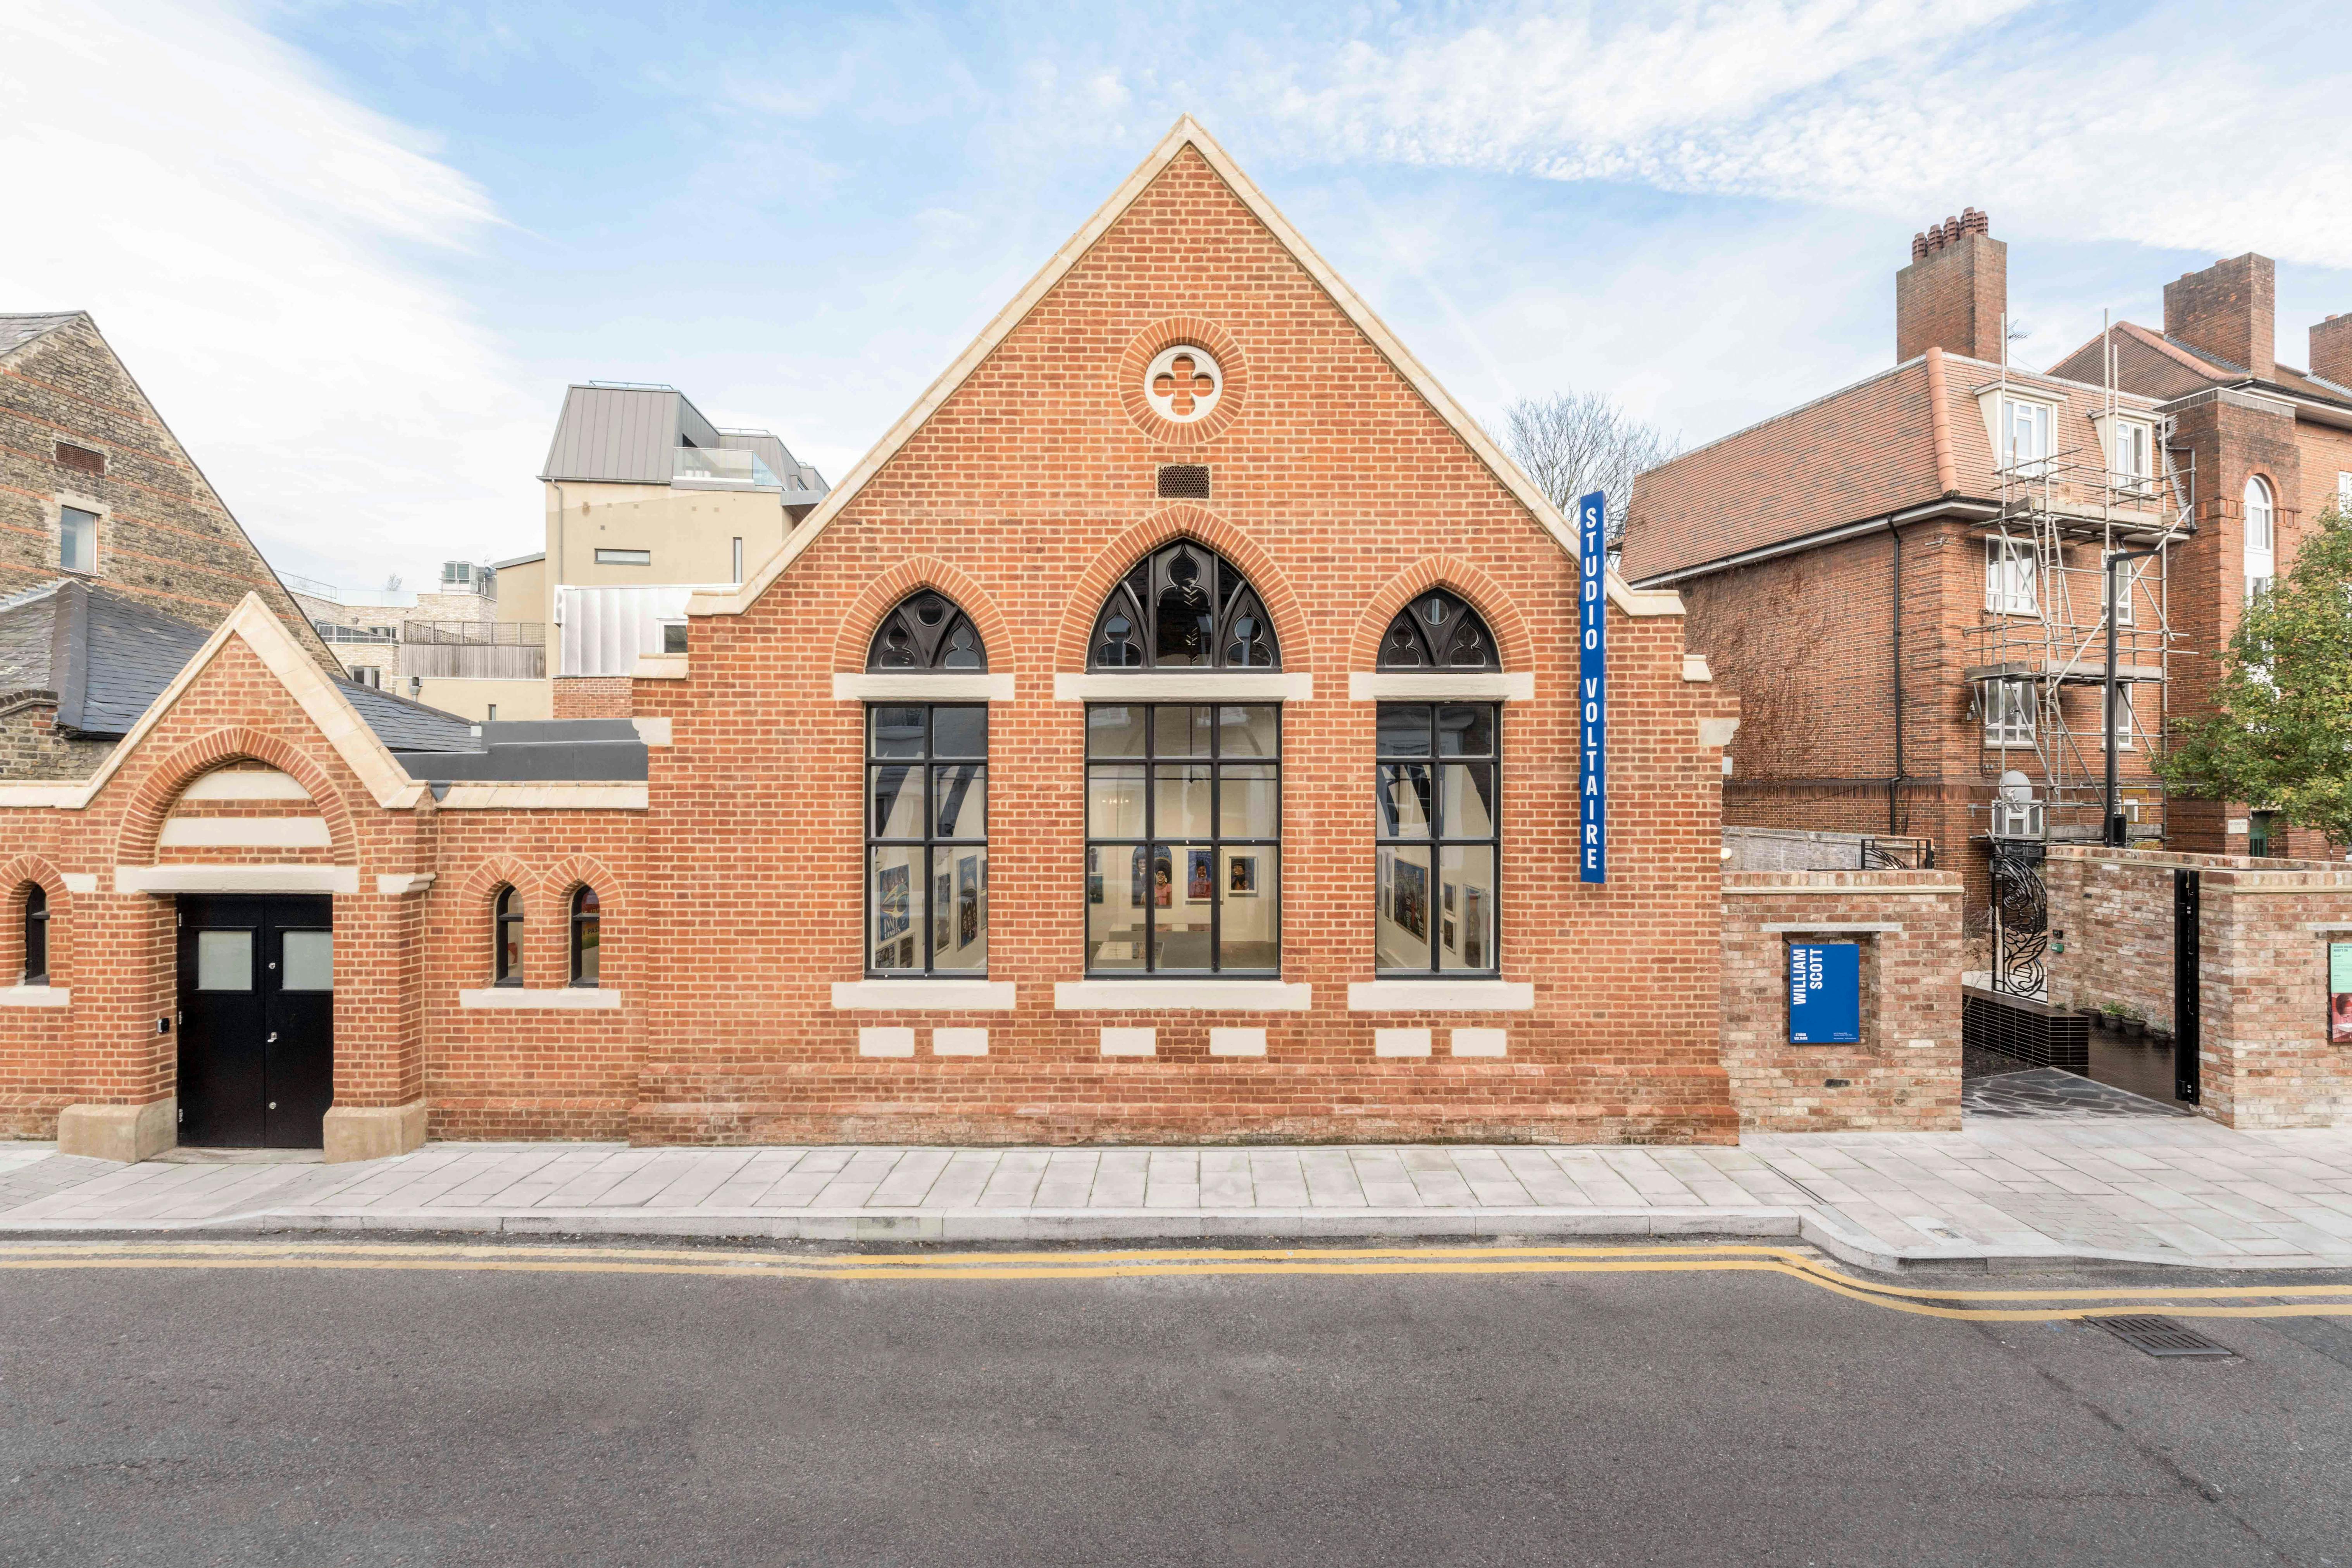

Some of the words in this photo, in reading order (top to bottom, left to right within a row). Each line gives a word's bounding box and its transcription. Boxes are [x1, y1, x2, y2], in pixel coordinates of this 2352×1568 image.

[1585, 507, 1597, 650] STUDIO
[1585, 677, 1598, 869] VOLTAIRE
[884, 927, 901, 939] LIMITS
[1793, 949, 1806, 1005] WILLIAM
[1809, 949, 1823, 989] SCOTT
